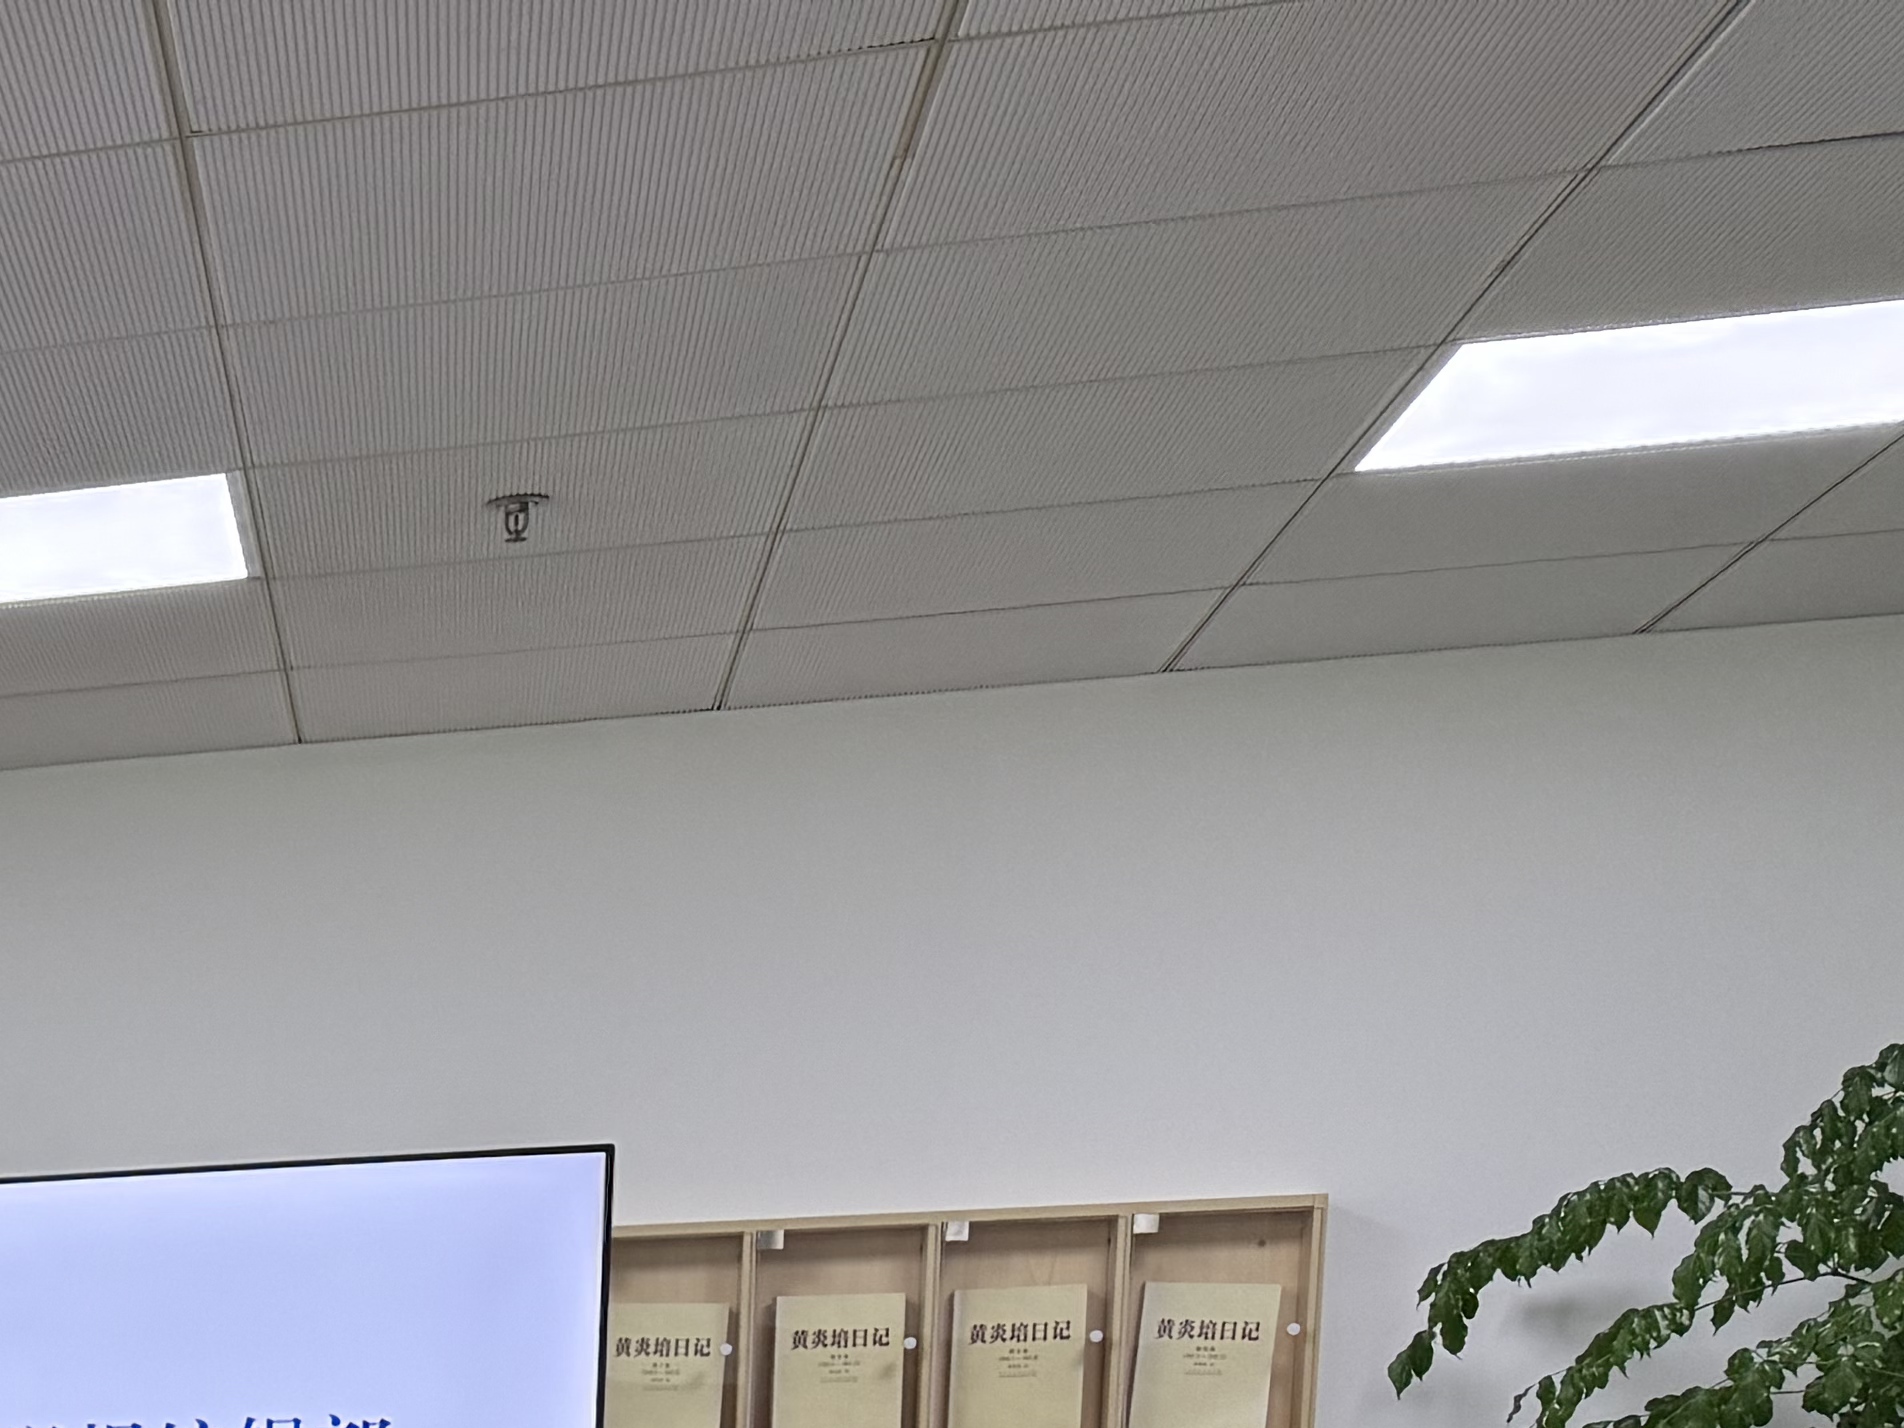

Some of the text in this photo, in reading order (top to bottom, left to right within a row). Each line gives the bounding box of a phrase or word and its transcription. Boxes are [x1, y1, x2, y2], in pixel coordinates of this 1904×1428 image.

[791, 1326, 891, 1351] 黄炎培日记
[968, 1319, 1072, 1345] 黄炎培日记
[1155, 1317, 1261, 1342] 黄炎培日记
[614, 1336, 712, 1358] 黄炎培日记
